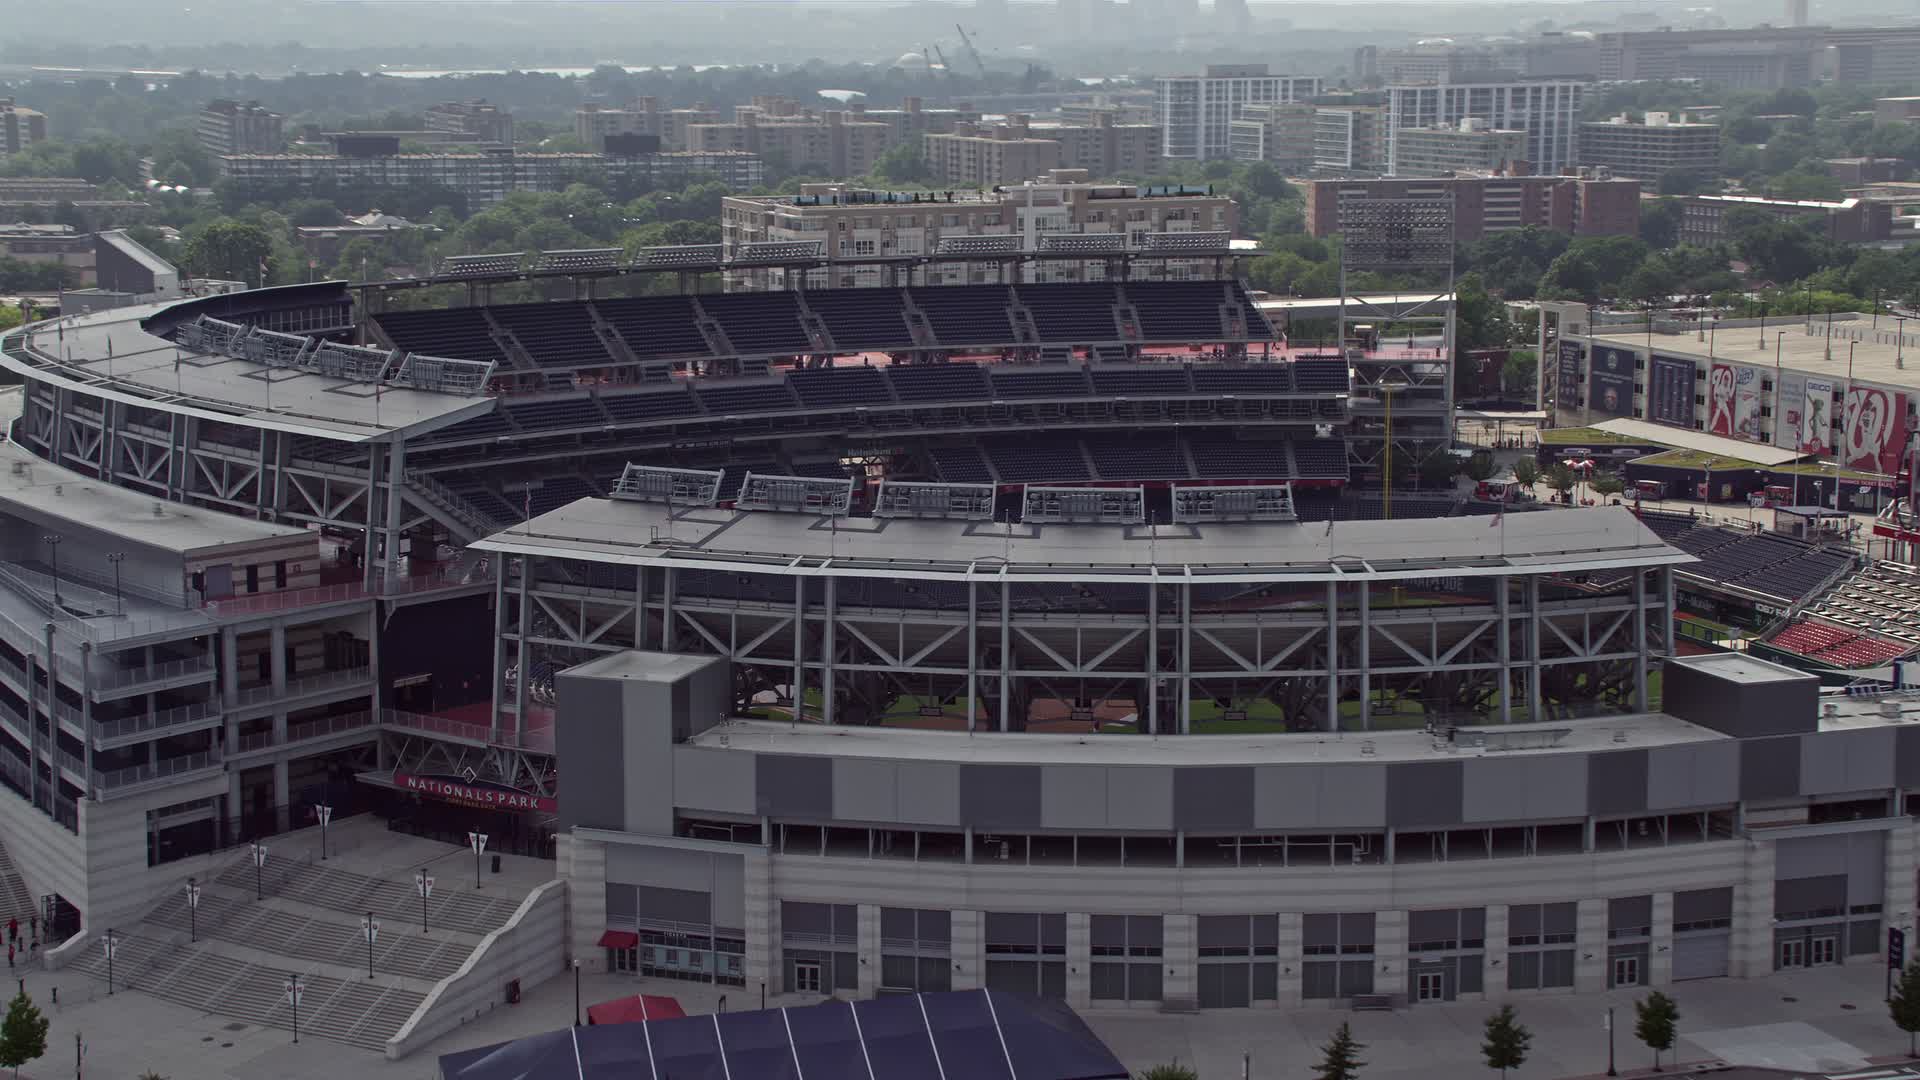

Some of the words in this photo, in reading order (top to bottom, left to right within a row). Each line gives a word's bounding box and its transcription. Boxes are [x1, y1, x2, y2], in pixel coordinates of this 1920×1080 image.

[1808, 382, 1831, 392] GEICO
[408, 778, 493, 802] NATIONALS
[498, 794, 539, 809] PARK
